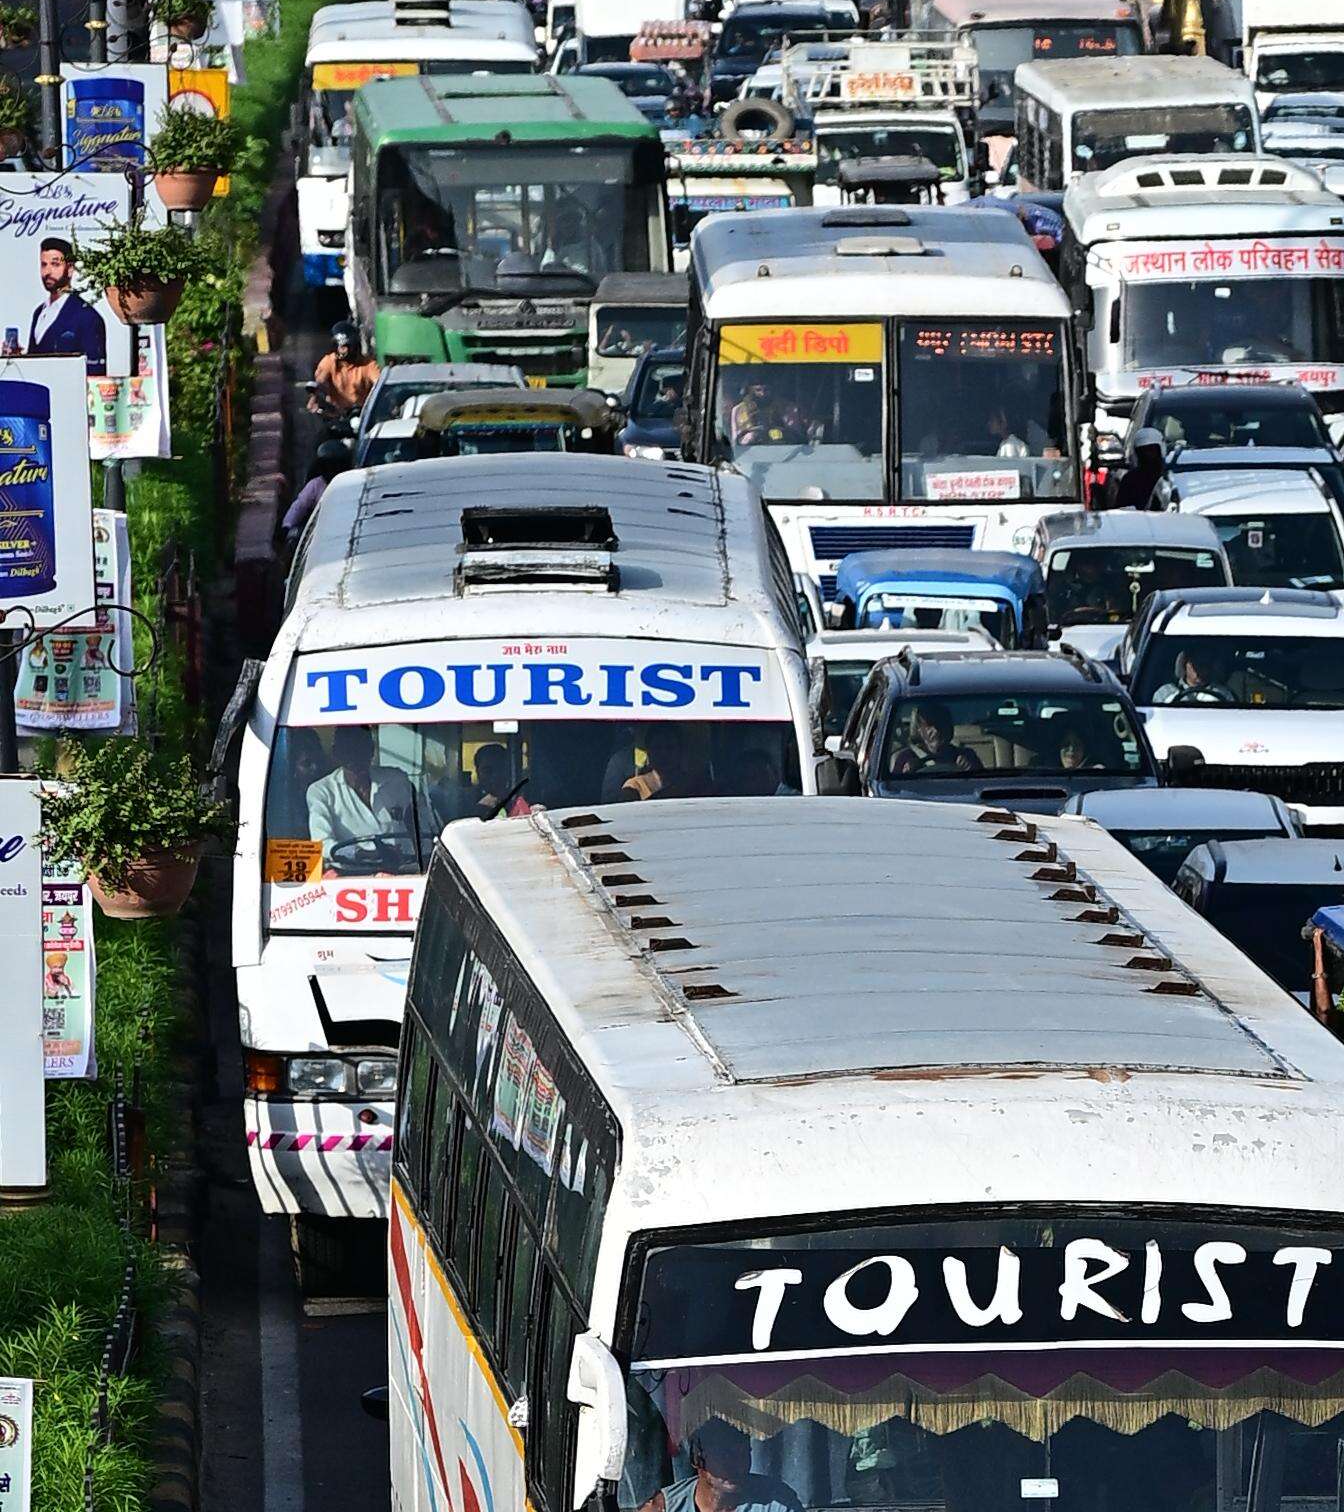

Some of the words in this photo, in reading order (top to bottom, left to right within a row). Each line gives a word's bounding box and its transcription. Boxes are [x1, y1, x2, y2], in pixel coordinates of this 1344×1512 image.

[1191, 243, 1233, 272] लोक
[1238, 241, 1309, 271] परिवहन
[803, 330, 851, 354] डिपो
[306, 662, 762, 713] TOURIST
[283, 860, 307, 872] 19
[336, 888, 418, 923] SH
[735, 1237, 1333, 1351] TOURIST
